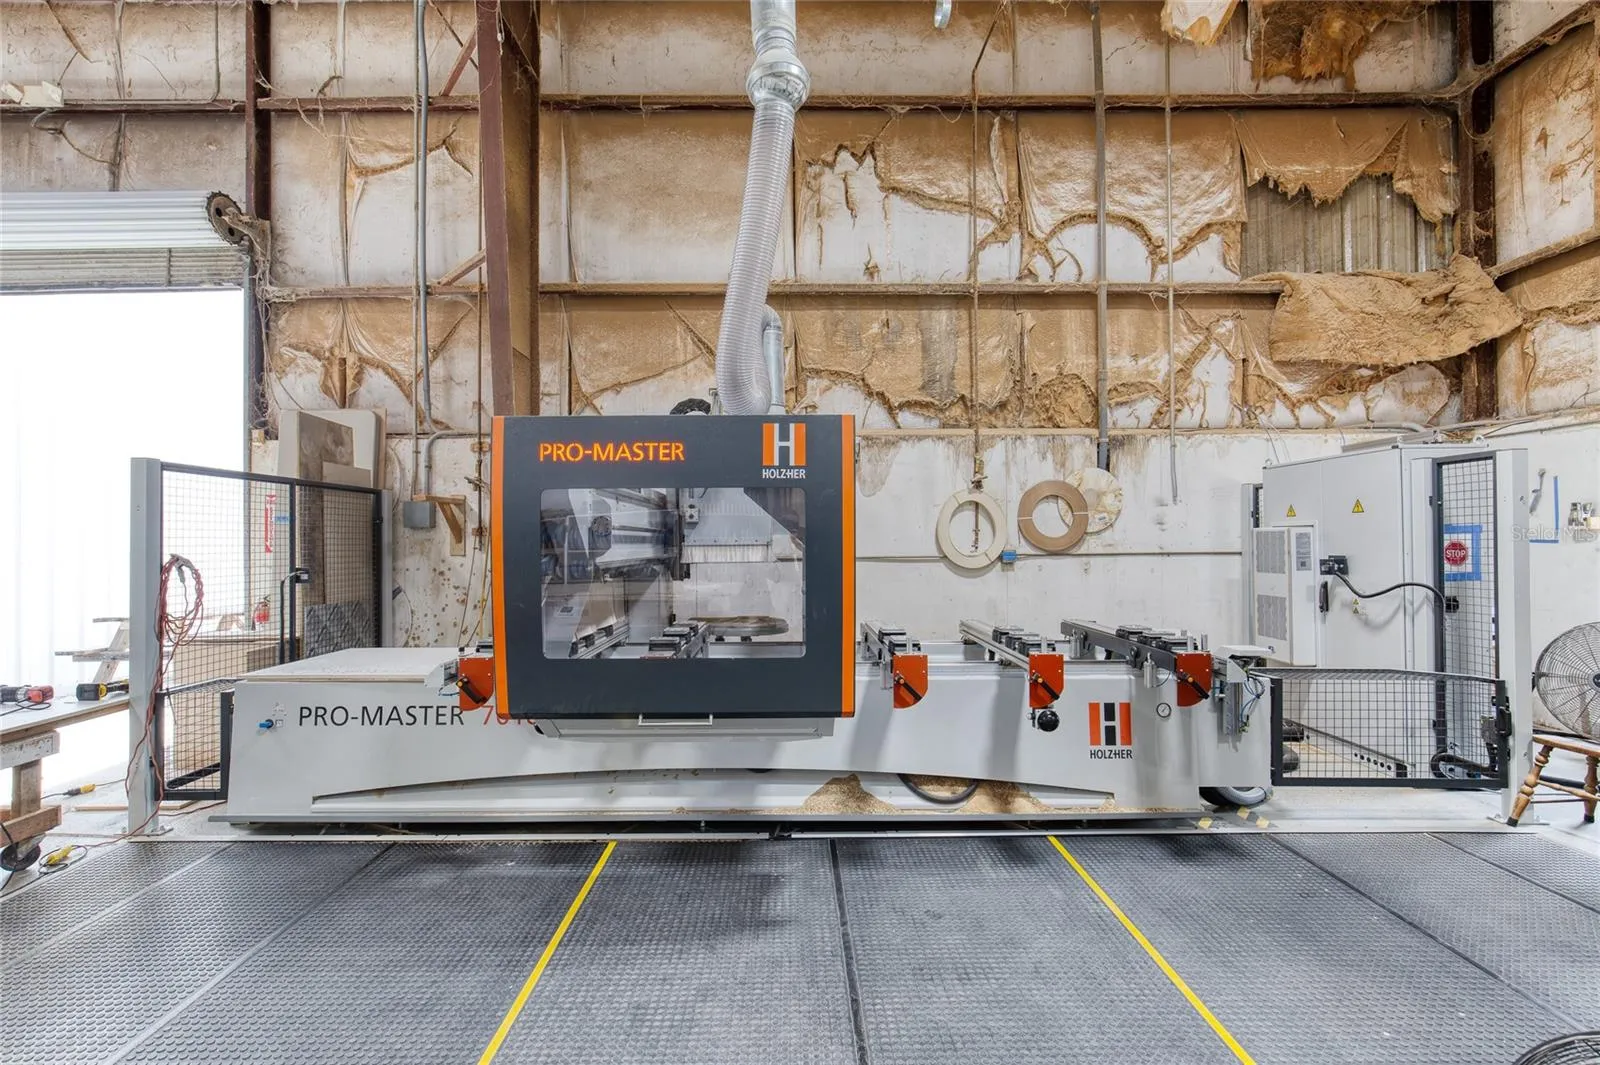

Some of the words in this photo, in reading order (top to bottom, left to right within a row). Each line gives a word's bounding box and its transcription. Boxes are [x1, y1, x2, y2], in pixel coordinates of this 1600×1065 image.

[538, 442, 685, 462] PRO-MASTER
[1446, 549, 1466, 558] STOP
[299, 705, 464, 726] PRO-MASTER
